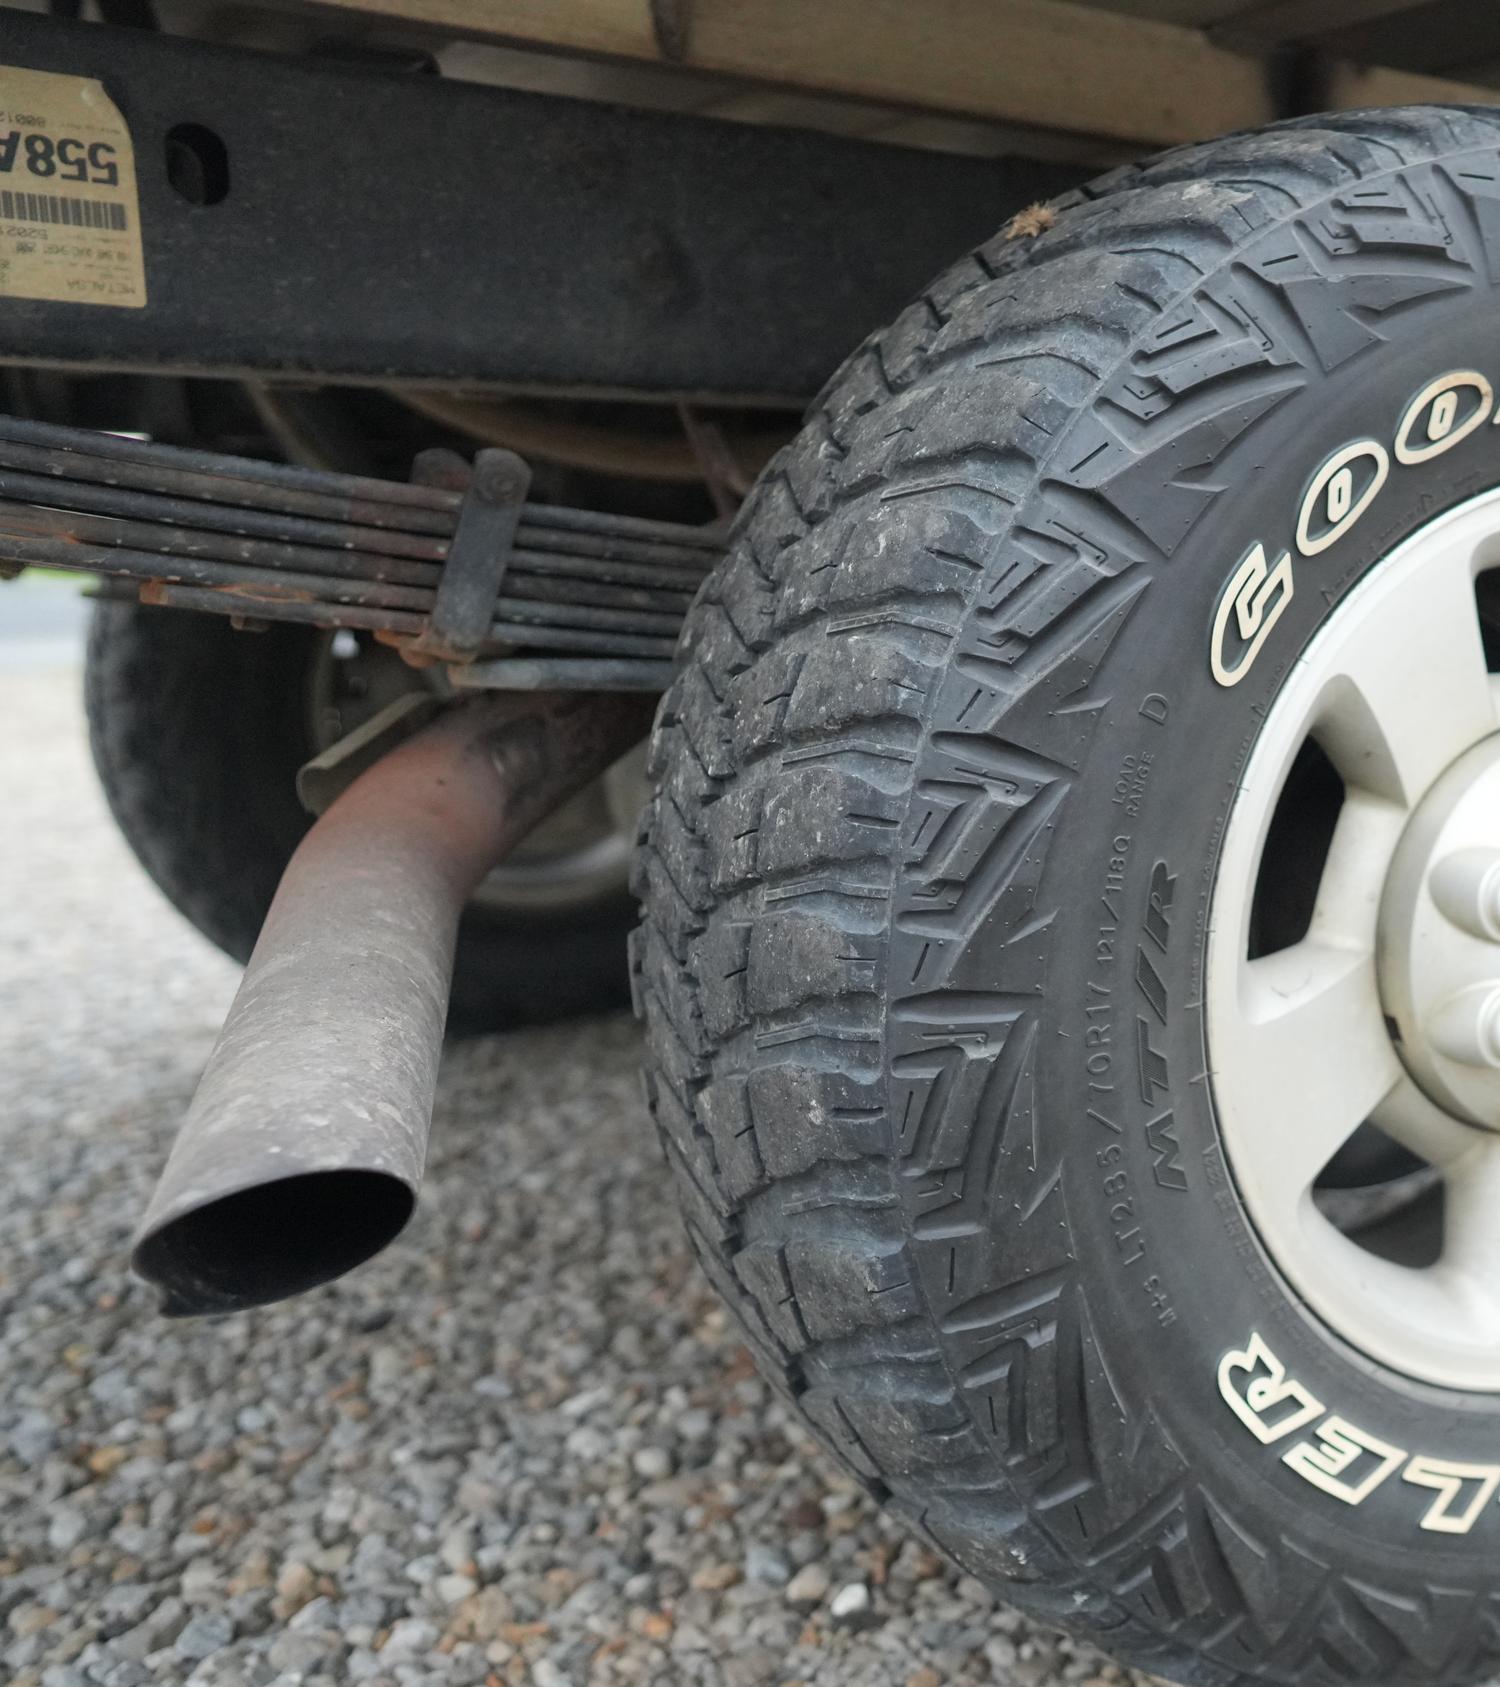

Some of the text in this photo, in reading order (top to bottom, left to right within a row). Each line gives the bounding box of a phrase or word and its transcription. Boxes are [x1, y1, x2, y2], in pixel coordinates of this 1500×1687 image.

[0, 130, 119, 186] 558A
[1112, 753, 1137, 805] LOAD
[1138, 692, 1169, 726] D
[1126, 751, 1155, 818] RANGE
